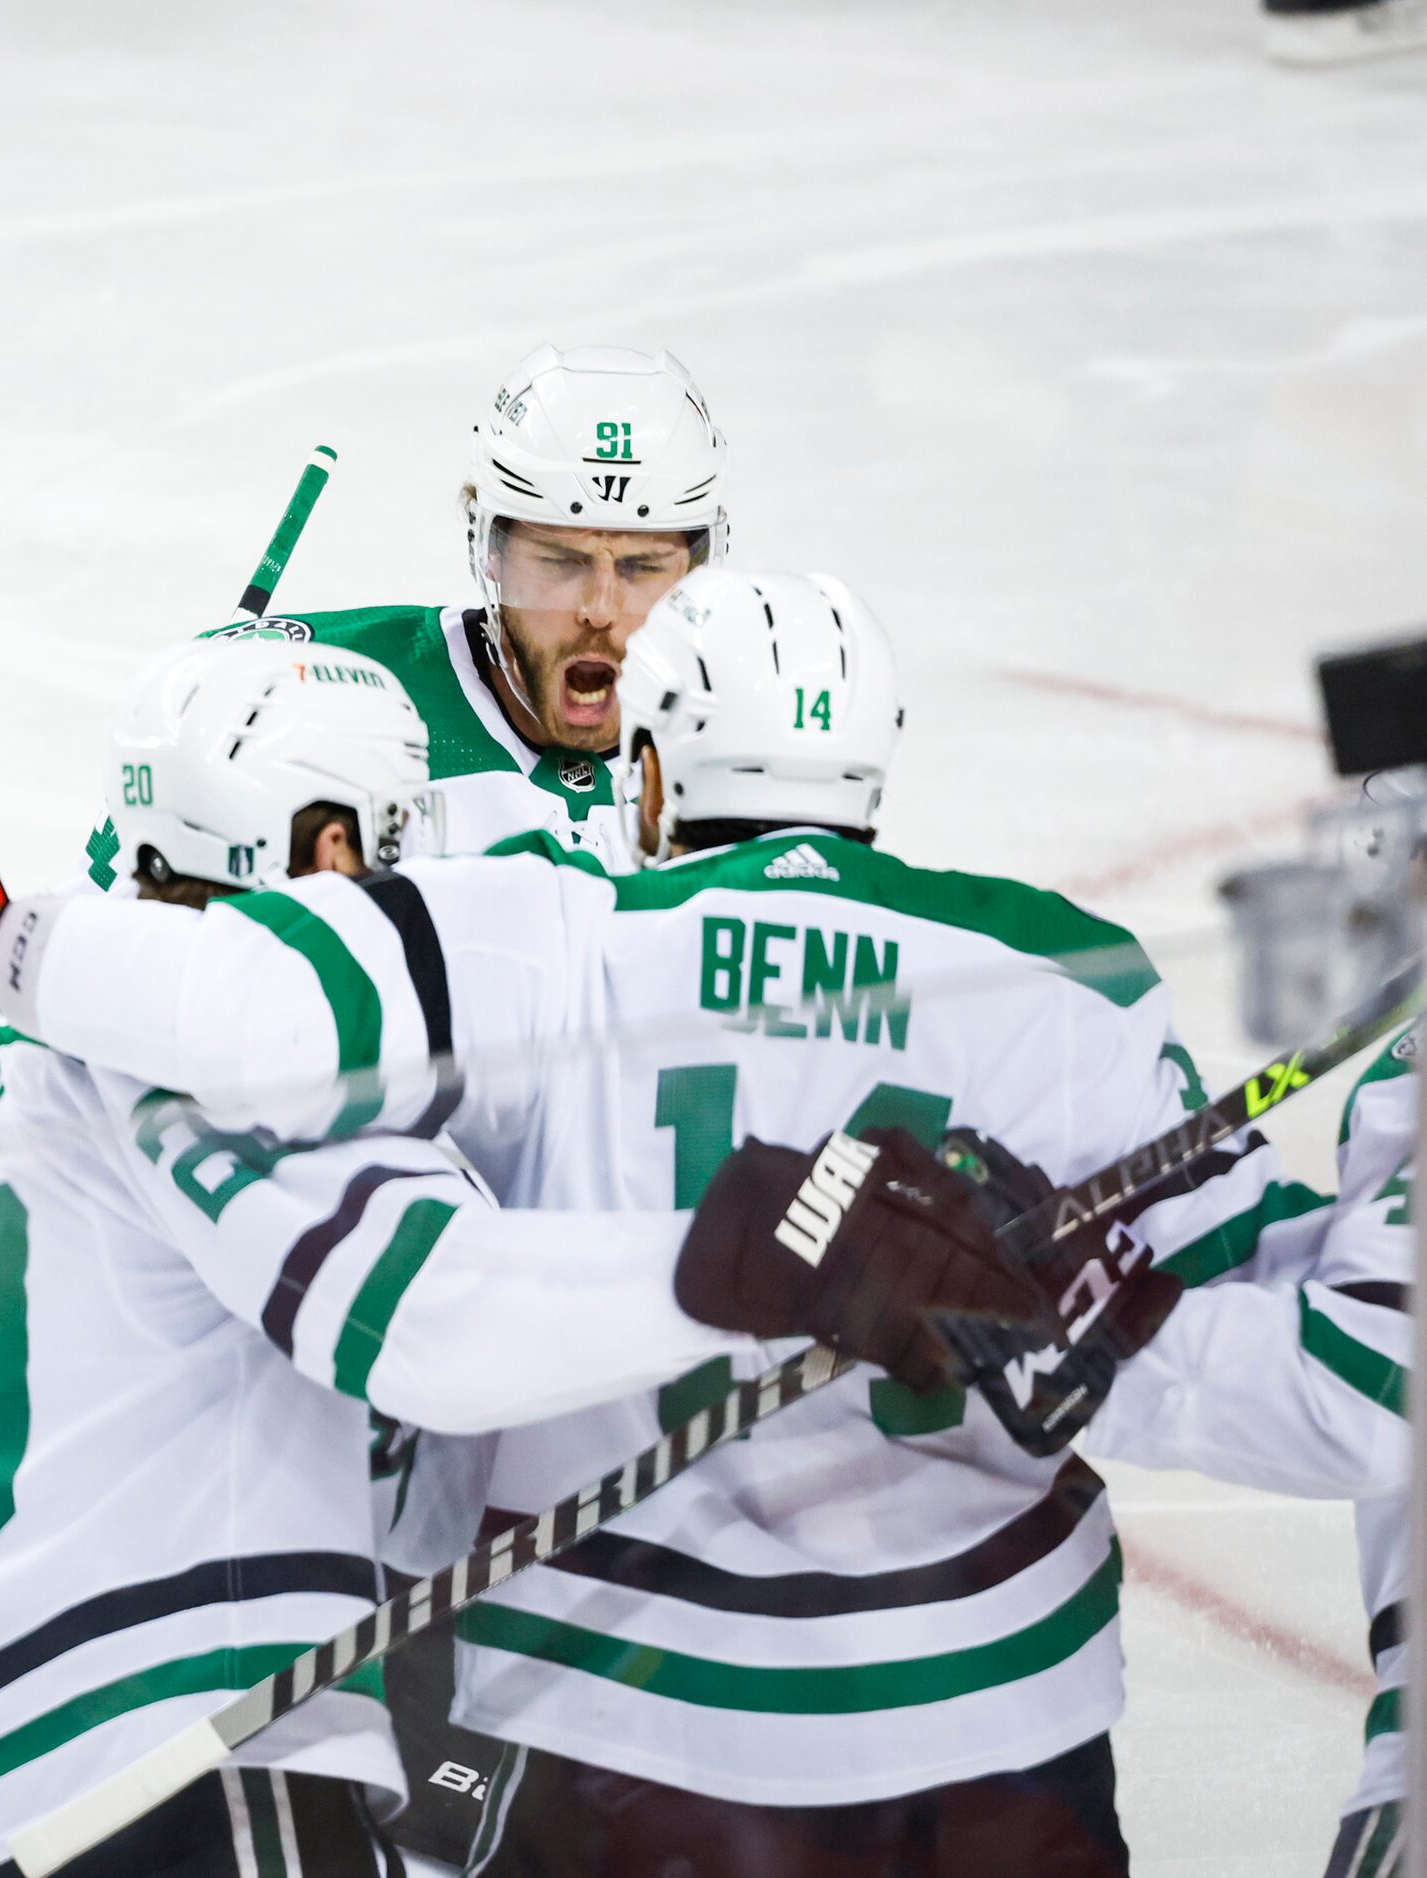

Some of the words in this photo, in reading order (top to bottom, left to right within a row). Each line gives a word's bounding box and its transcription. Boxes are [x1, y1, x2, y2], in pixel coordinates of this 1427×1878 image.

[596, 421, 633, 459] 91
[793, 687, 832, 732] 14
[123, 764, 153, 806] 20
[763, 863, 841, 883] adidas
[699, 914, 911, 1052] BENN
[1244, 1049, 1310, 1119] LX
